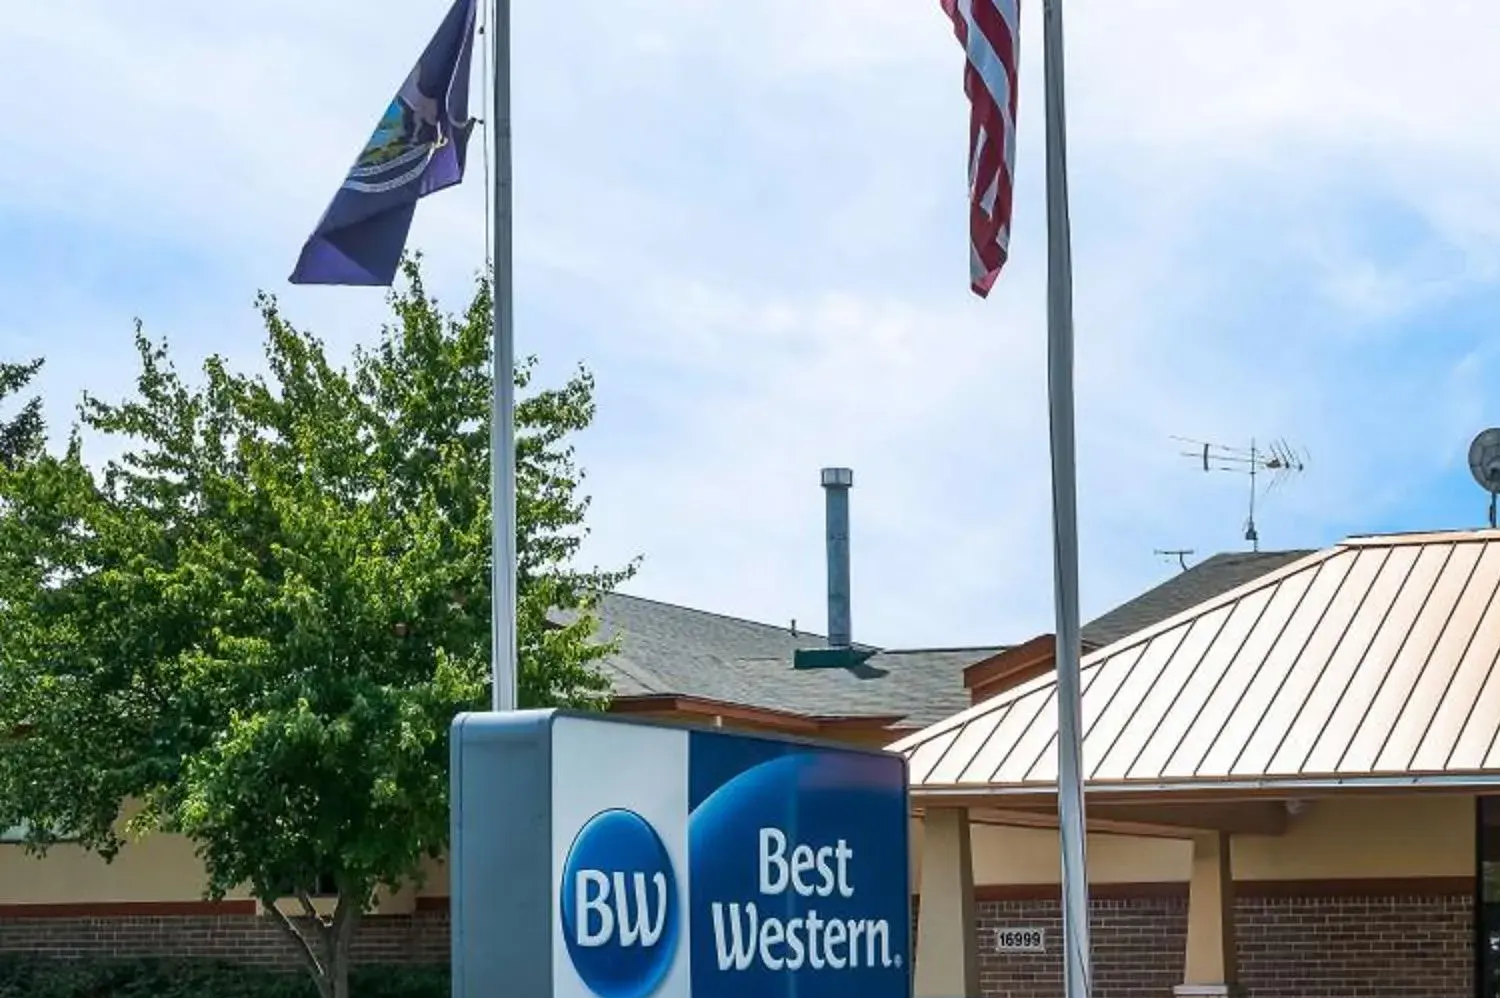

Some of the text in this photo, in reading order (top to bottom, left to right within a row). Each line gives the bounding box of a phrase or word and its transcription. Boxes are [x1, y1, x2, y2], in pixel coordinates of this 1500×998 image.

[759, 827, 854, 897] Best
[575, 868, 667, 948] BW
[1000, 931, 1041, 947] 16999
